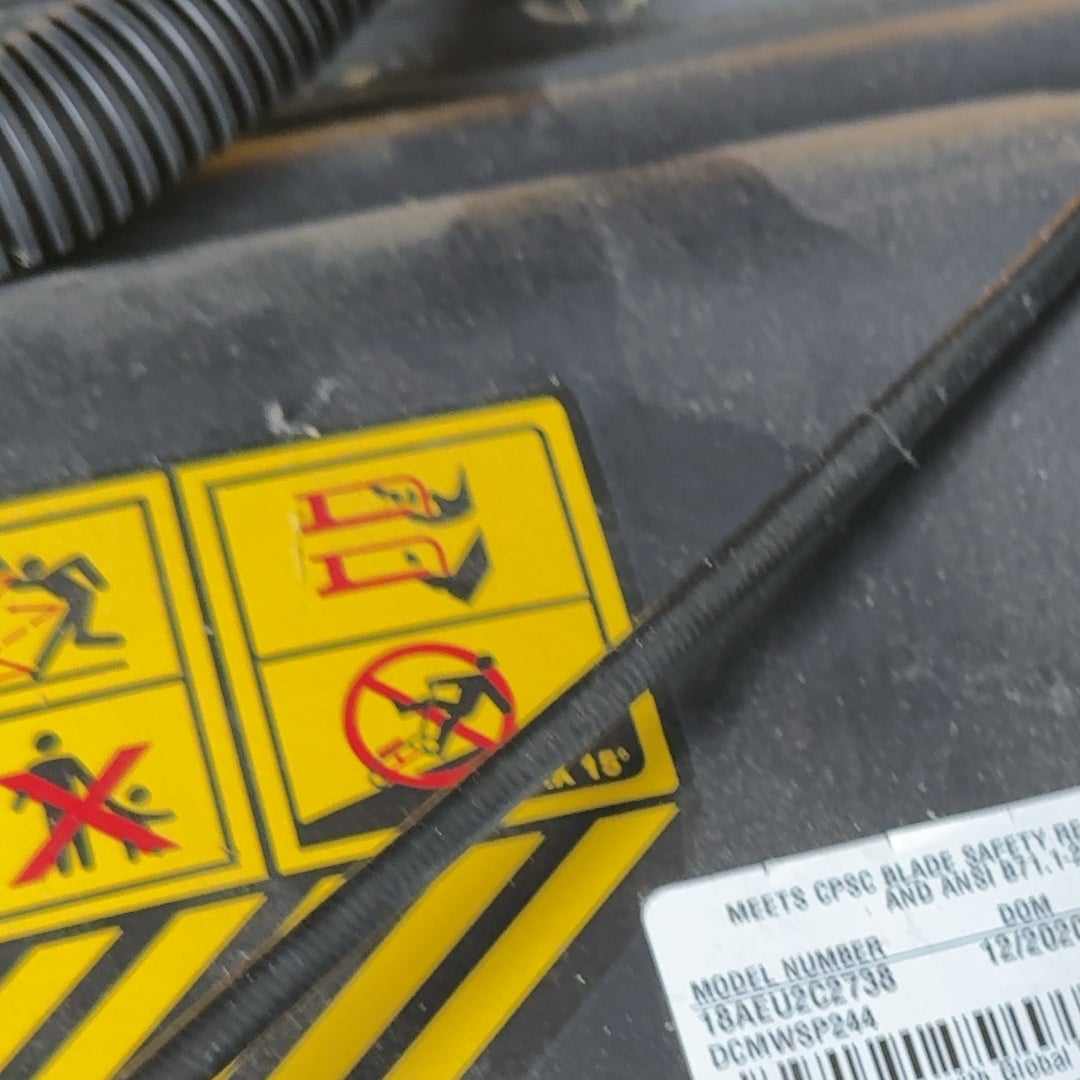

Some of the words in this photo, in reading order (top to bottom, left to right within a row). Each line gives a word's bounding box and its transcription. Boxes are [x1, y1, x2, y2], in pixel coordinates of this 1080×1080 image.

[725, 885, 808, 926] MEETS
[813, 869, 877, 906] CPSC
[880, 850, 955, 887] BLADE
[961, 827, 1047, 871] SAFETY
[885, 879, 934, 912] AND
[941, 862, 997, 899] ANSI
[997, 893, 1053, 928] DOM
[690, 964, 775, 1005] MODEL
[781, 935, 886, 979] NUMBER
[698, 962, 898, 1036] 18AEU2C2738
[709, 1004, 879, 1071] DCMWSP244
